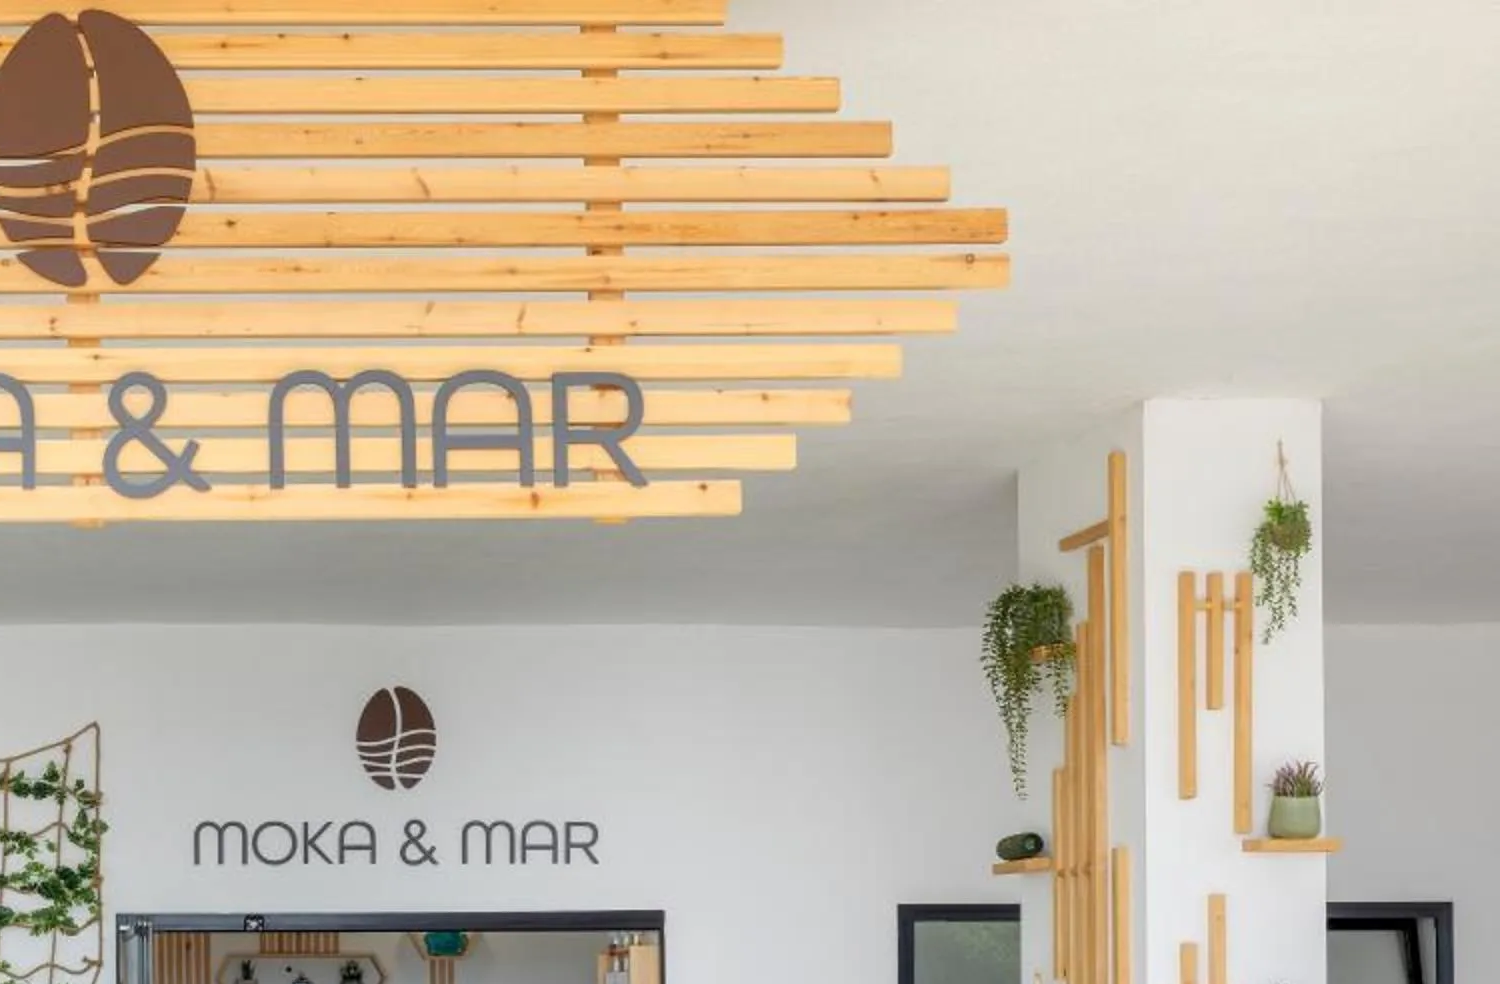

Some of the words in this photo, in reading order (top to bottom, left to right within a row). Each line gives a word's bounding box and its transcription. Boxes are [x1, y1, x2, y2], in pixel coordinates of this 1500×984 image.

[102, 370, 212, 499] &
[268, 369, 649, 489] MAR
[193, 820, 377, 866] MOKA
[399, 819, 438, 866] &
[461, 820, 599, 865] MAR
